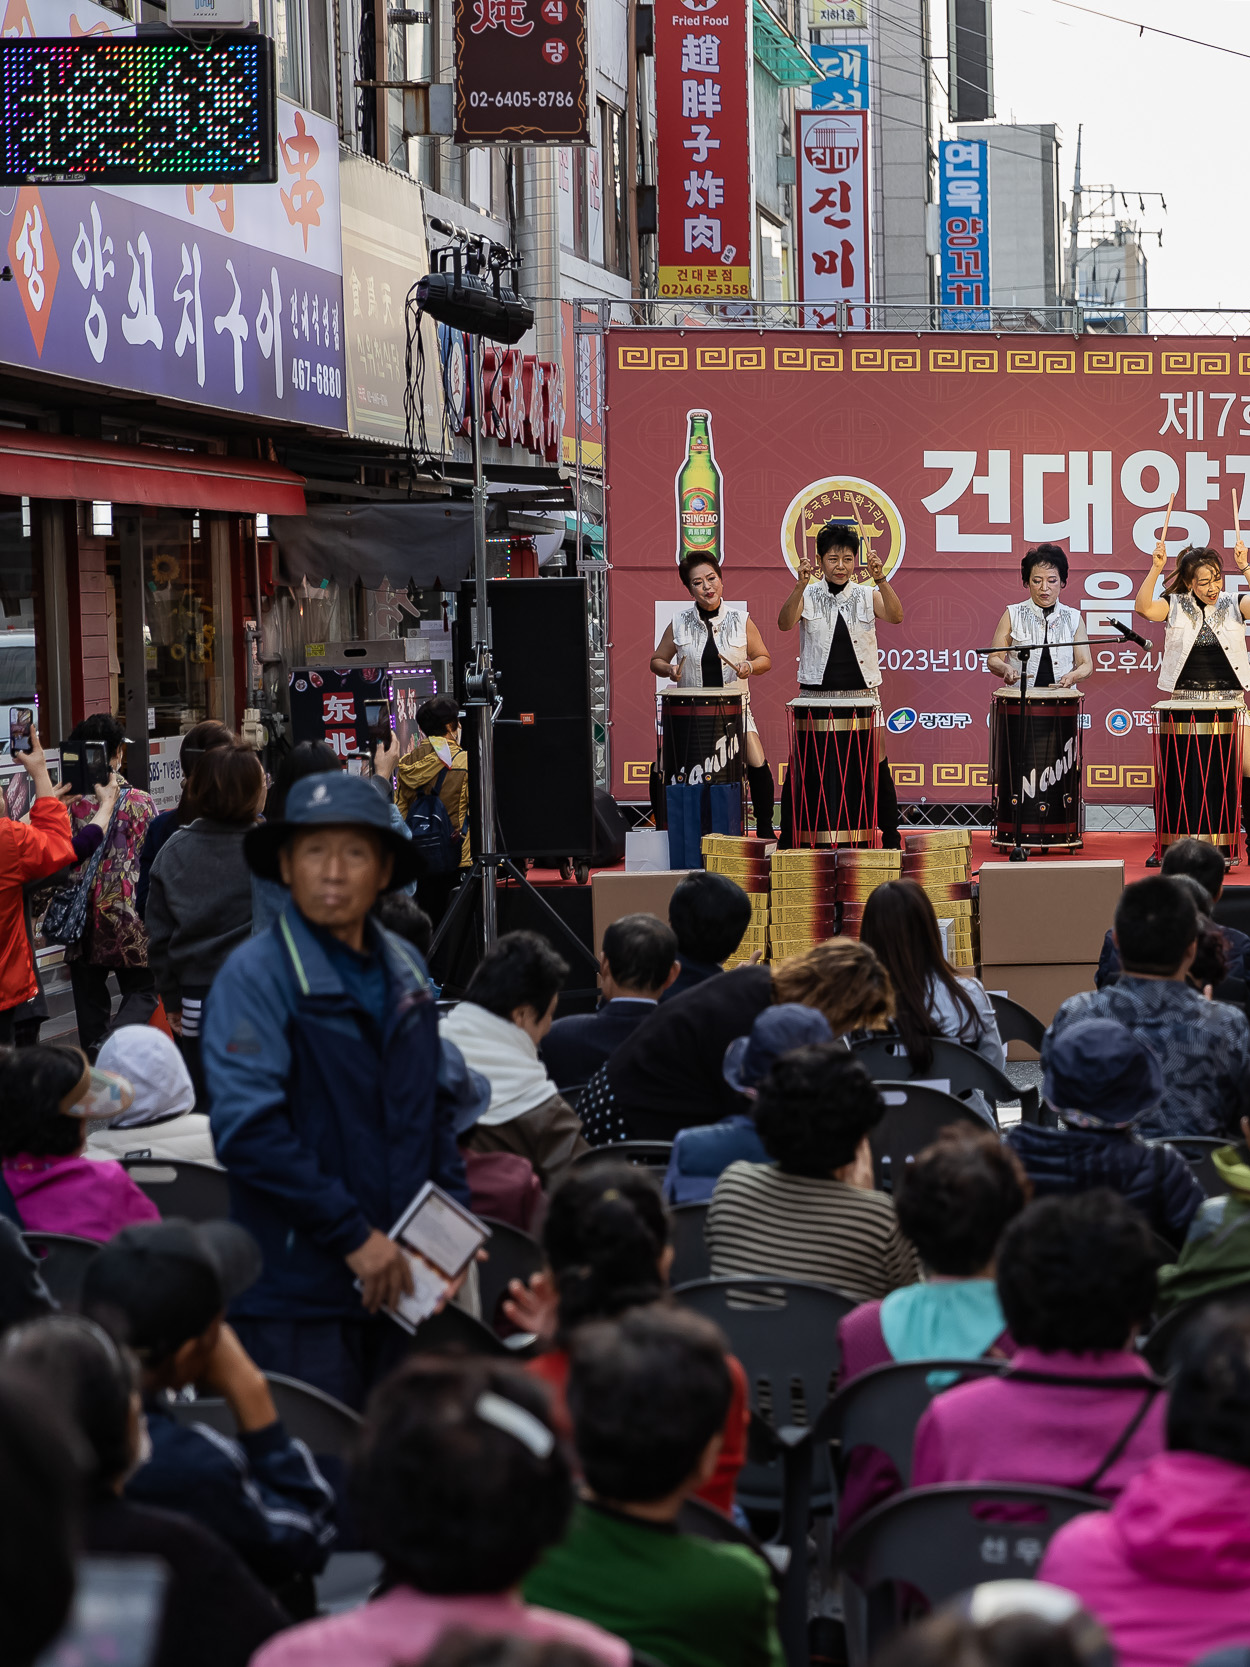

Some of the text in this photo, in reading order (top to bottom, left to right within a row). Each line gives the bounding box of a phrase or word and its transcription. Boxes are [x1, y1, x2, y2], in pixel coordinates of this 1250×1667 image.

[672, 15, 729, 26] Fried Food
[470, 91, 574, 107] 02-6405-8786
[681, 33, 724, 254] 趙胖子炸肉
[677, 269, 732, 282] 건대본점
[661, 284, 748, 296] 02)462-5358
[72, 200, 283, 400] 양꼬치구이
[292, 358, 341, 400] 467-6880
[681, 513, 718, 523] TSINGTAO
[322, 695, 360, 757] 东北
[918, 713, 973, 730] 광진구
